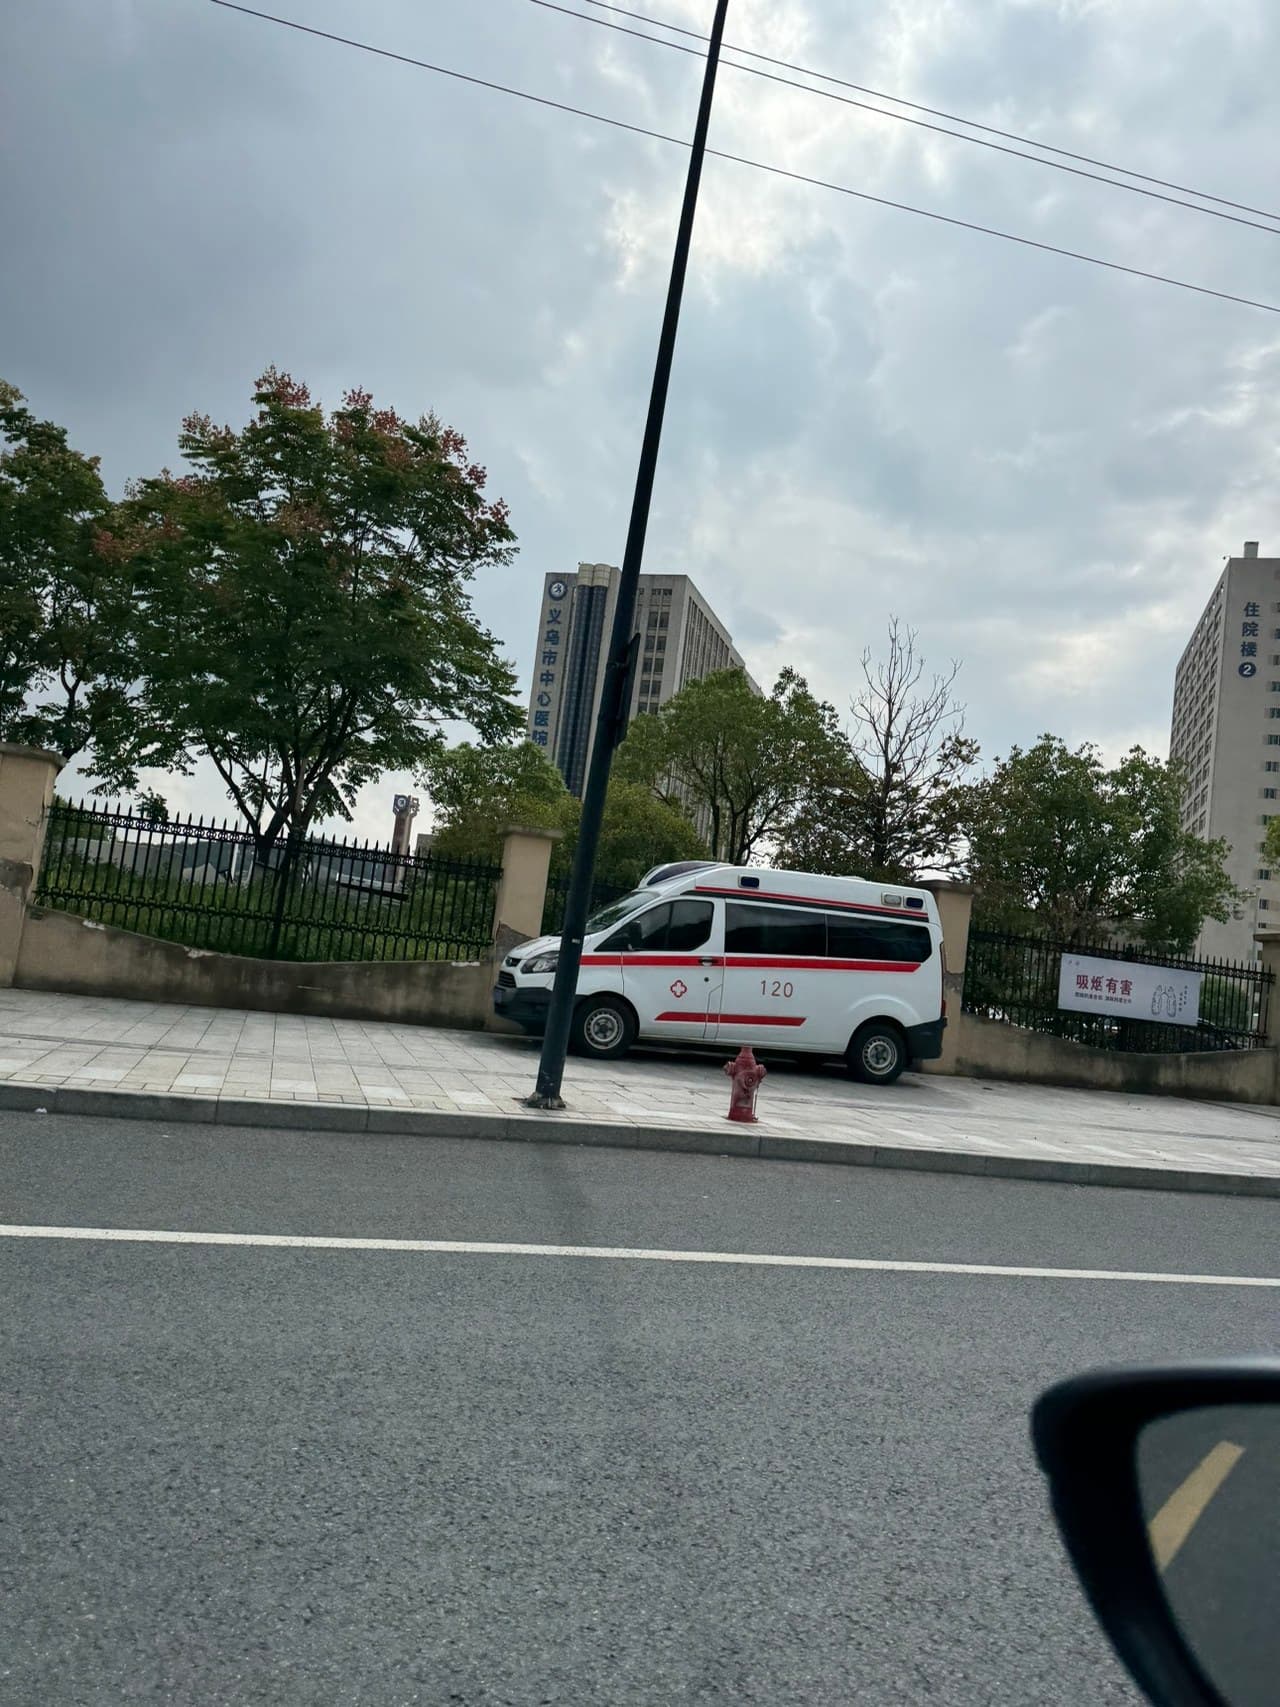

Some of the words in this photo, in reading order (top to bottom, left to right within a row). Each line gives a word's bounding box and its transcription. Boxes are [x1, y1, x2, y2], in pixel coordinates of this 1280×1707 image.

[531, 607, 562, 747] 义乌市中心医院
[760, 979, 794, 998] 120
